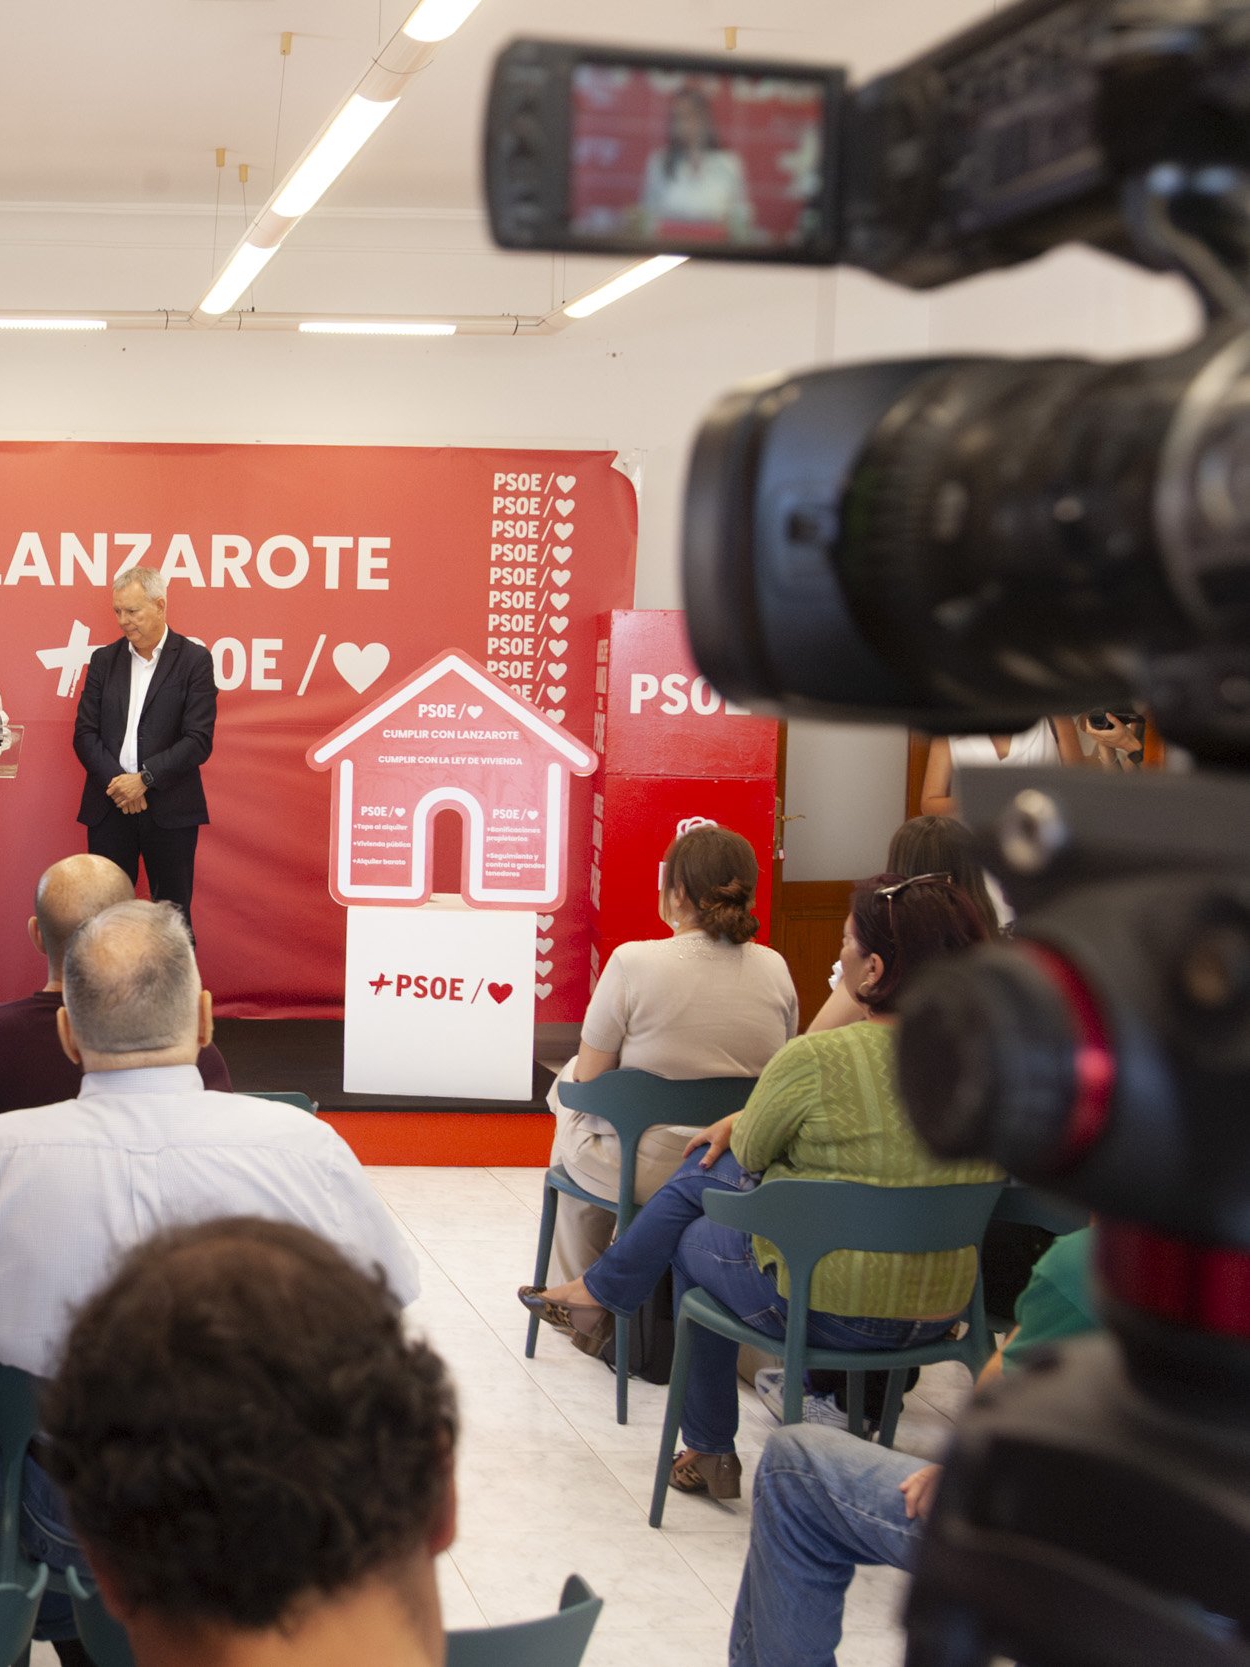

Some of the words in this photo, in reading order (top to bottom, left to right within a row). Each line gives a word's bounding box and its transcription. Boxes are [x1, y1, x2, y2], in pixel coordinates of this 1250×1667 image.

[382, 729, 429, 739] CUMPLIR
[431, 729, 456, 739] CON
[457, 730, 519, 740] LANZAROTE
[378, 755, 417, 764] CUMPLIR
[417, 756, 438, 764] CON
[439, 756, 450, 764] LA
[451, 756, 466, 765] LEY
[467, 757, 480, 765] DE
[481, 757, 523, 766] VIVIENDA
[382, 824, 408, 832] alquiler
